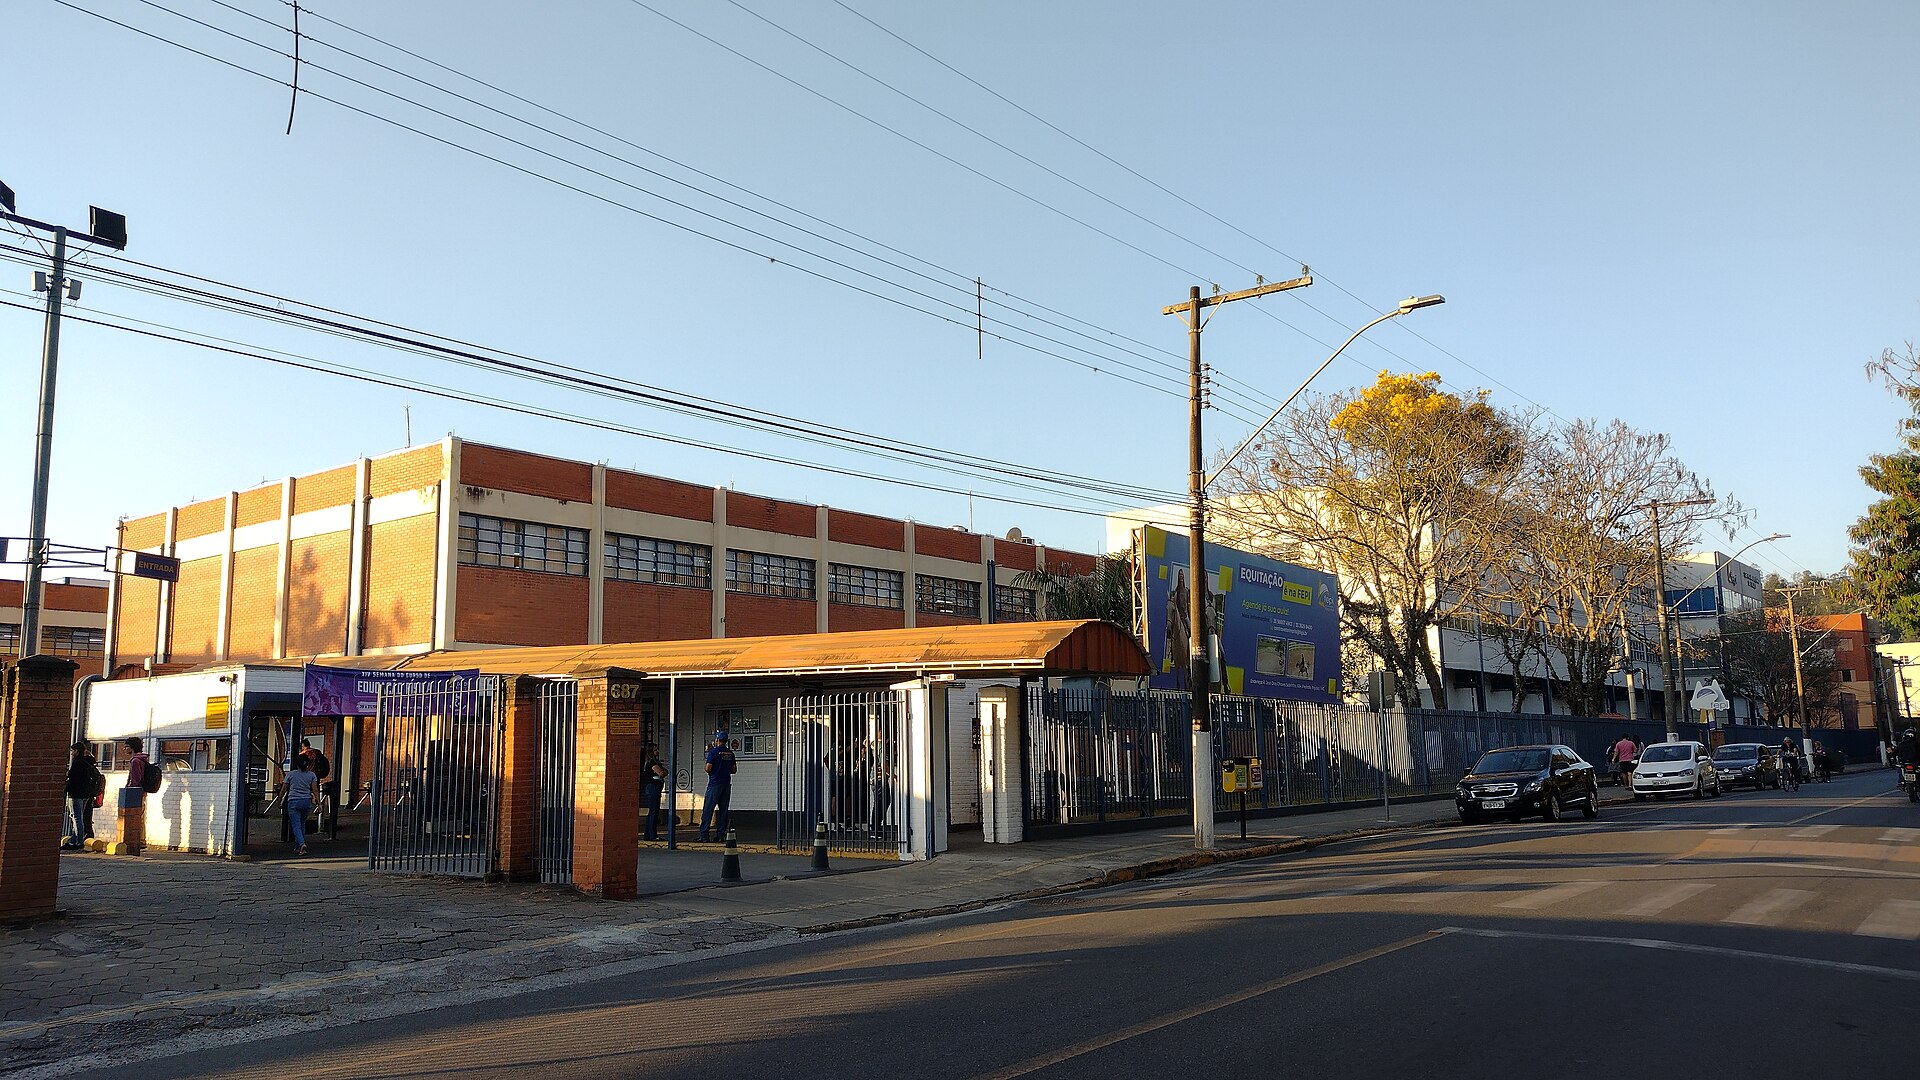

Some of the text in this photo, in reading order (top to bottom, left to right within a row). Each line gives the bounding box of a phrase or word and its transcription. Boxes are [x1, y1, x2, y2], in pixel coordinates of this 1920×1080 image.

[138, 560, 174, 573] ENTRADA
[1240, 567, 1283, 588] EQUITAÇÃO
[1283, 585, 1311, 600] é na FEPI
[611, 683, 640, 699] 687
